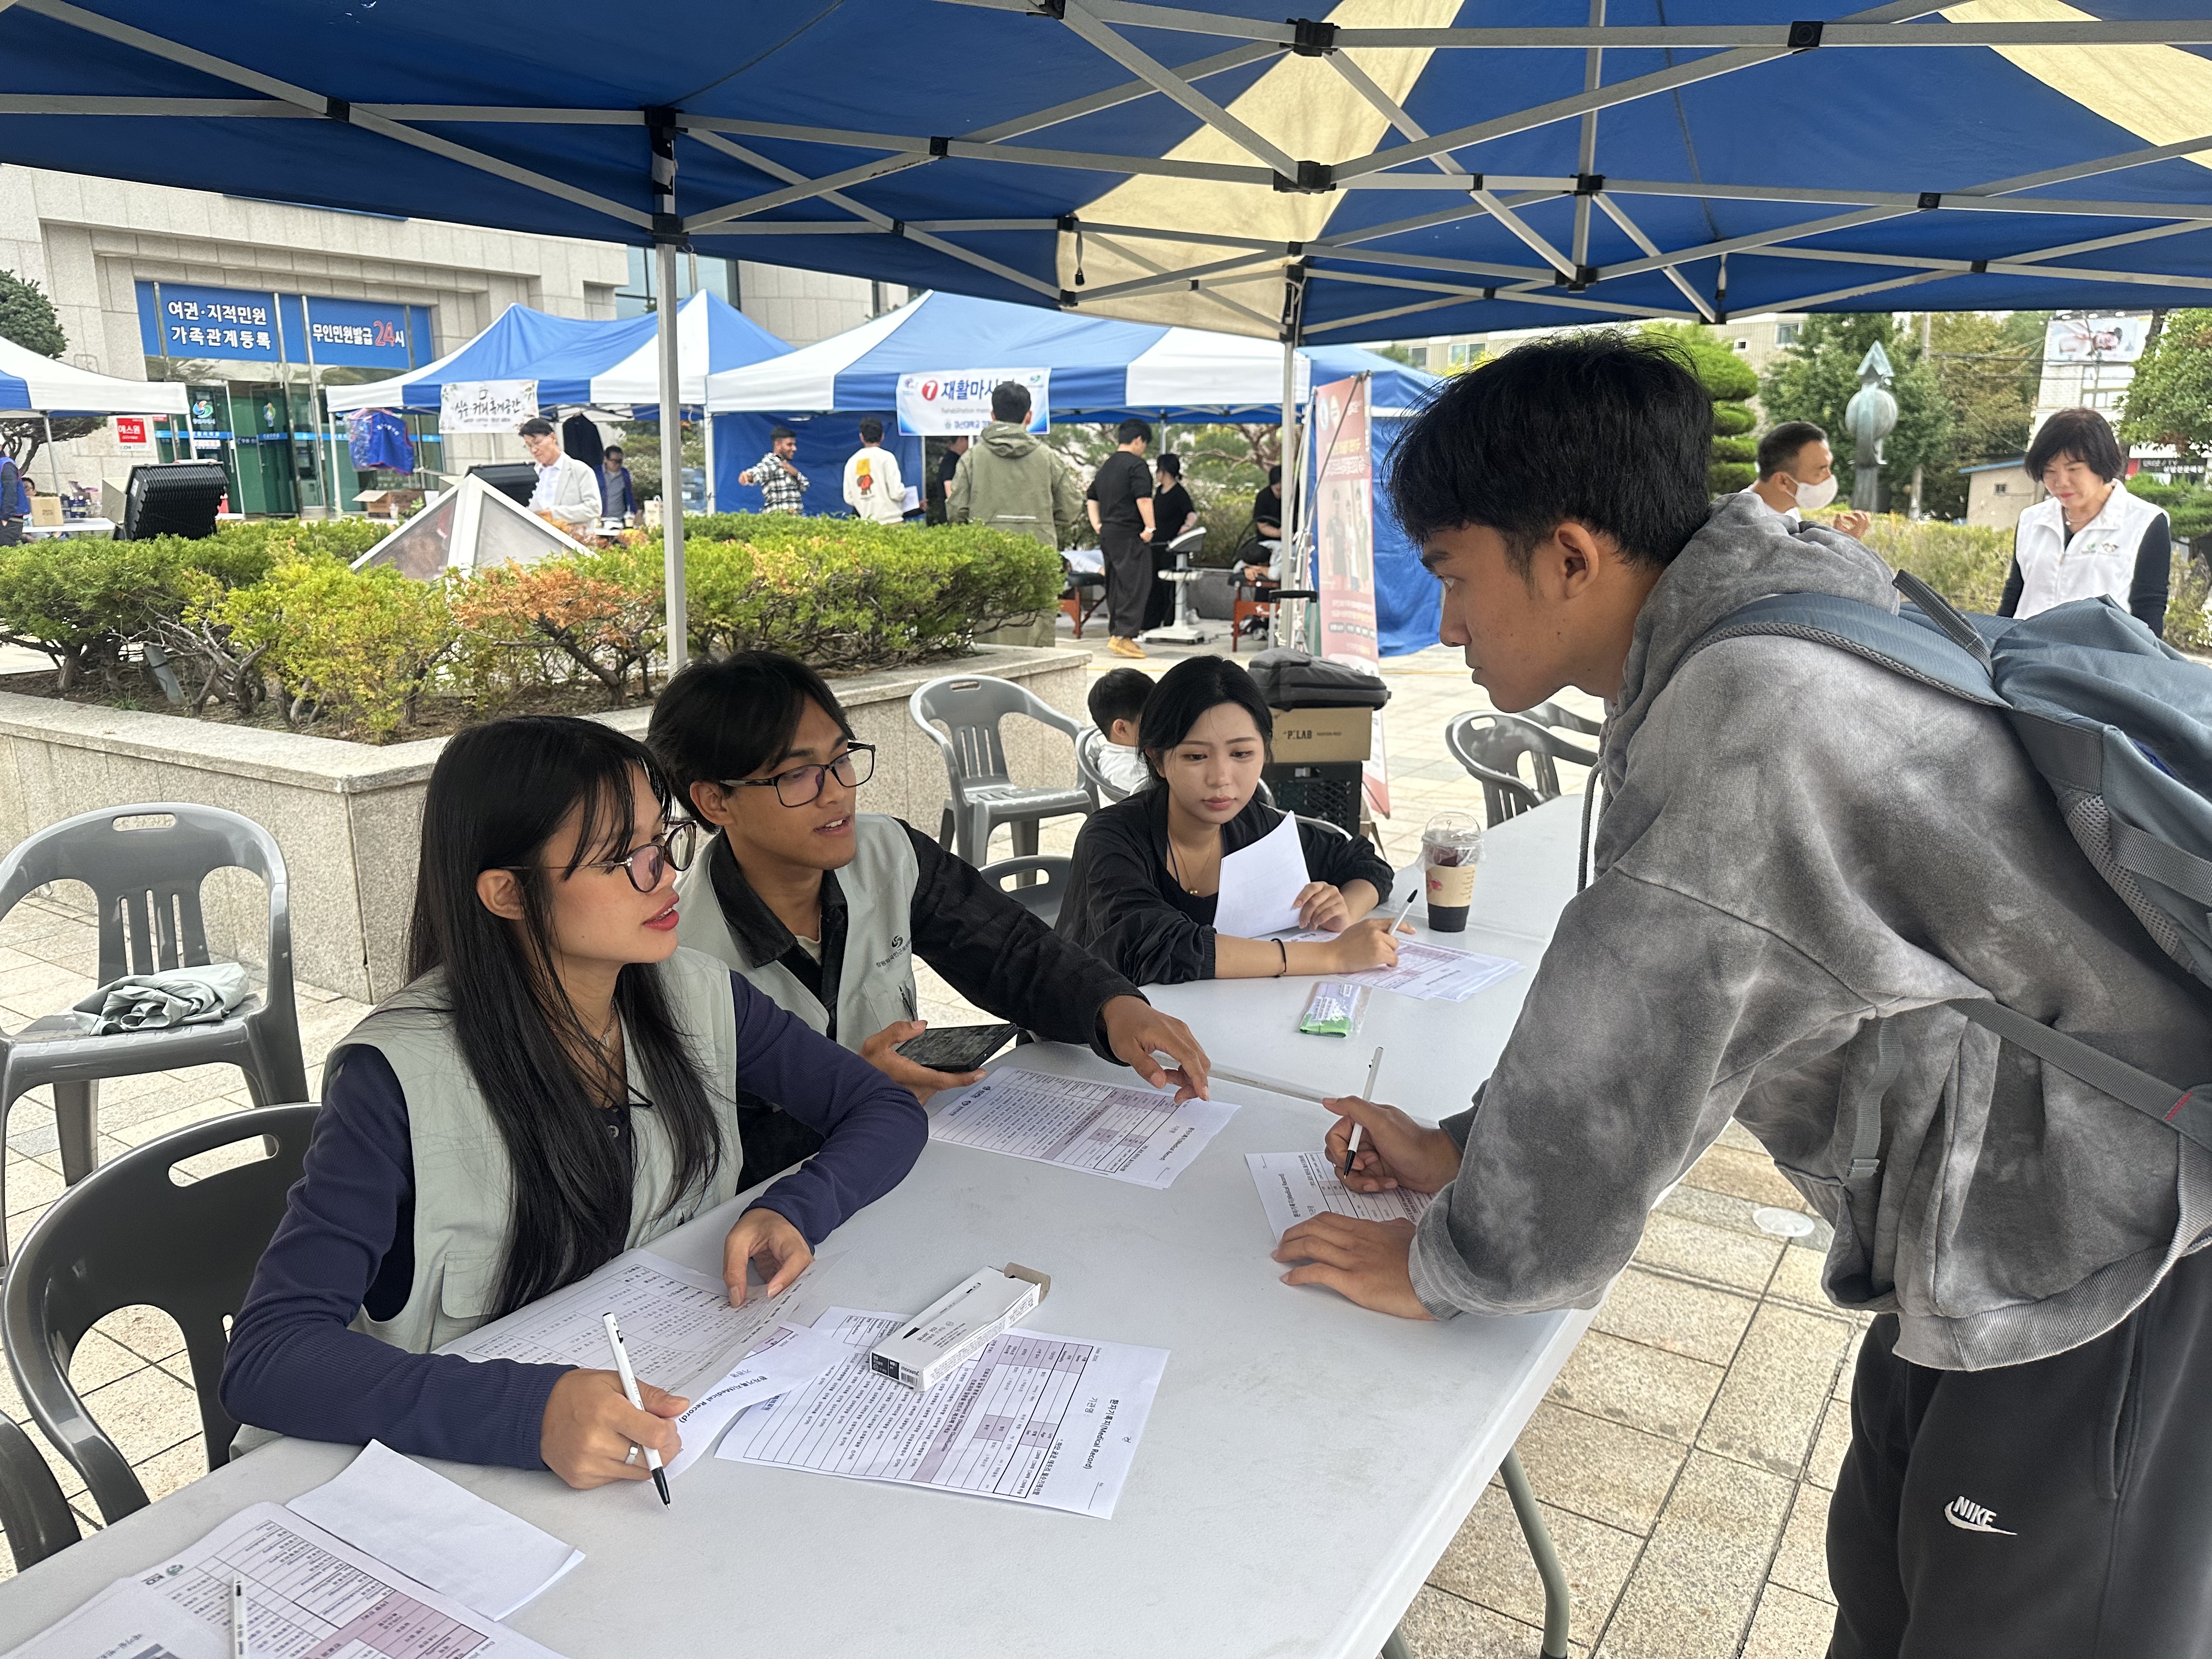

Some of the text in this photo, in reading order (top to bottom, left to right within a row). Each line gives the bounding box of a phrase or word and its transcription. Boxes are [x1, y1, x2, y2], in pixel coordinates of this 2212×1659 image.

[171, 326, 271, 349] 가족관계등록
[941, 379, 1013, 400] 재활마사
[678, 1401, 707, 1423] Record)
[1082, 1448, 1099, 1469] Record)
[1953, 1496, 1997, 1527] NIKE
